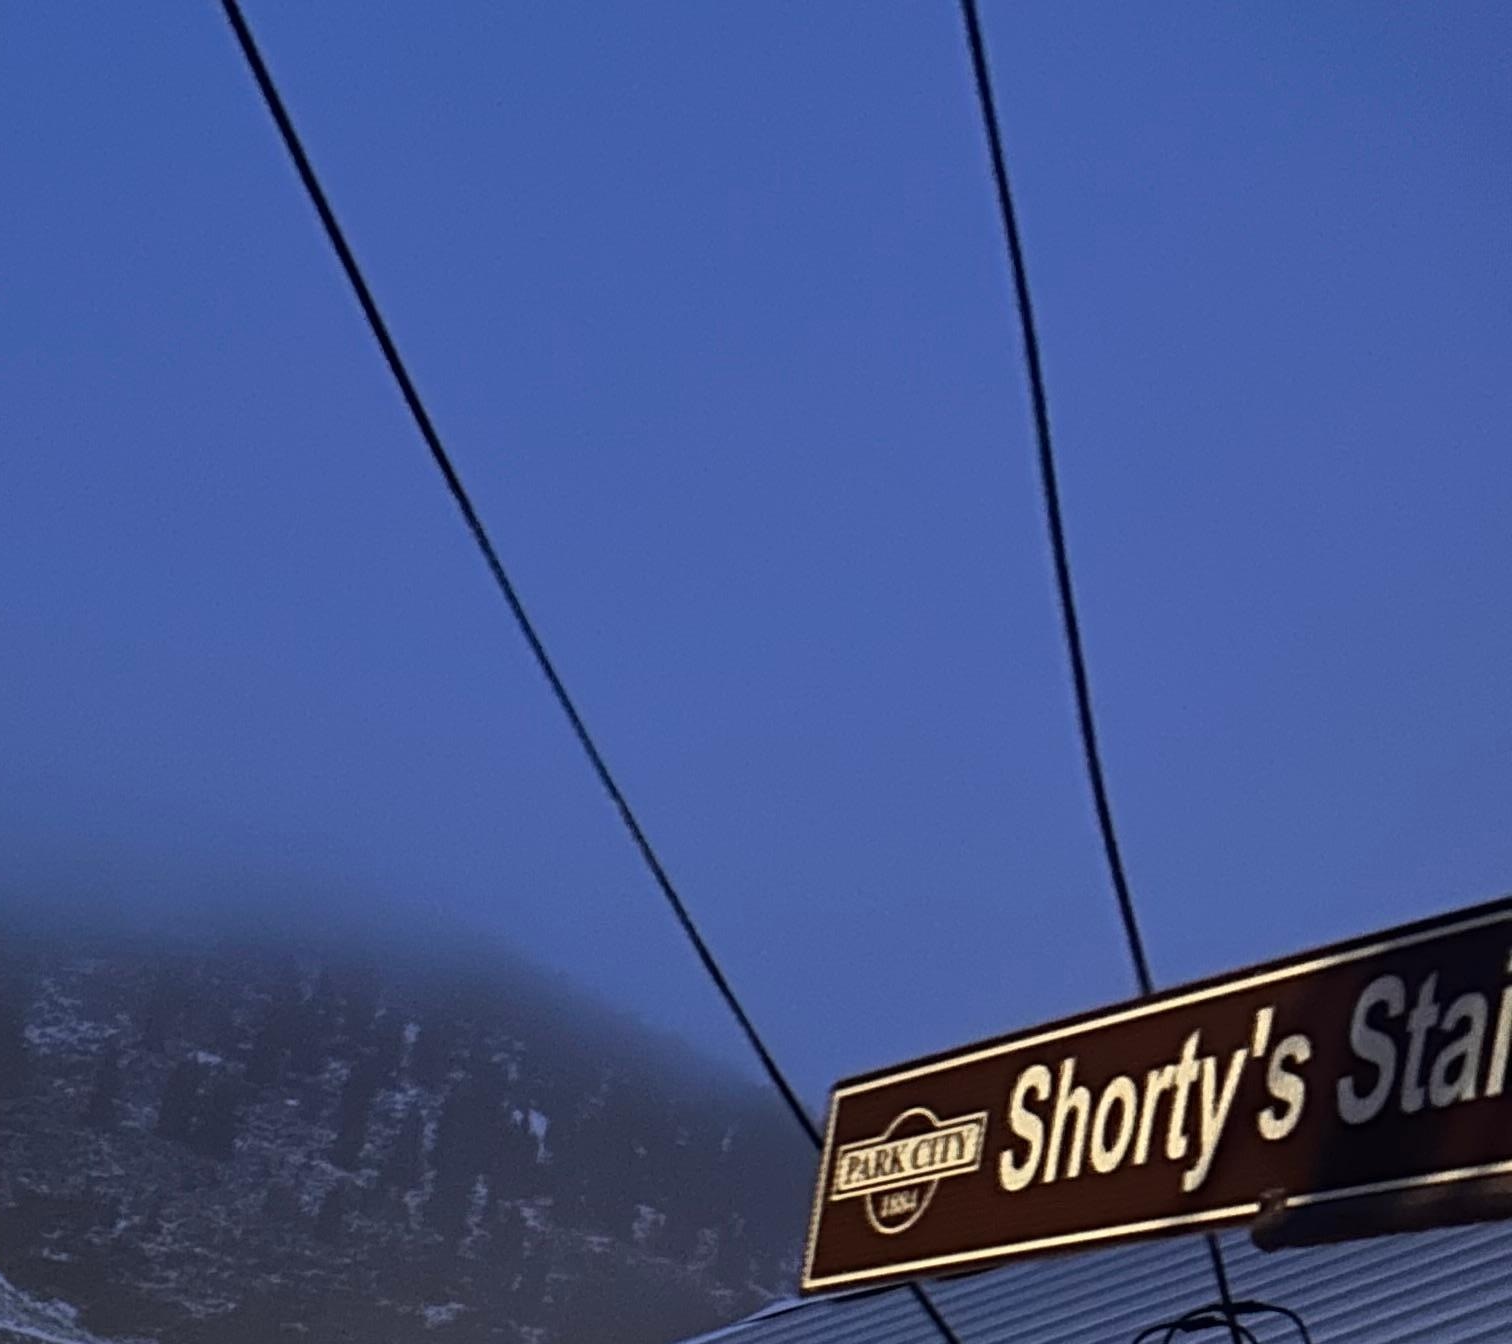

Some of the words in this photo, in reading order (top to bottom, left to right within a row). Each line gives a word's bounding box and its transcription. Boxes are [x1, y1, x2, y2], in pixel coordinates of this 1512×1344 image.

[844, 1143, 909, 1186] PARK
[910, 1128, 974, 1170] CITY
[999, 1006, 1312, 1194] Shorty's
